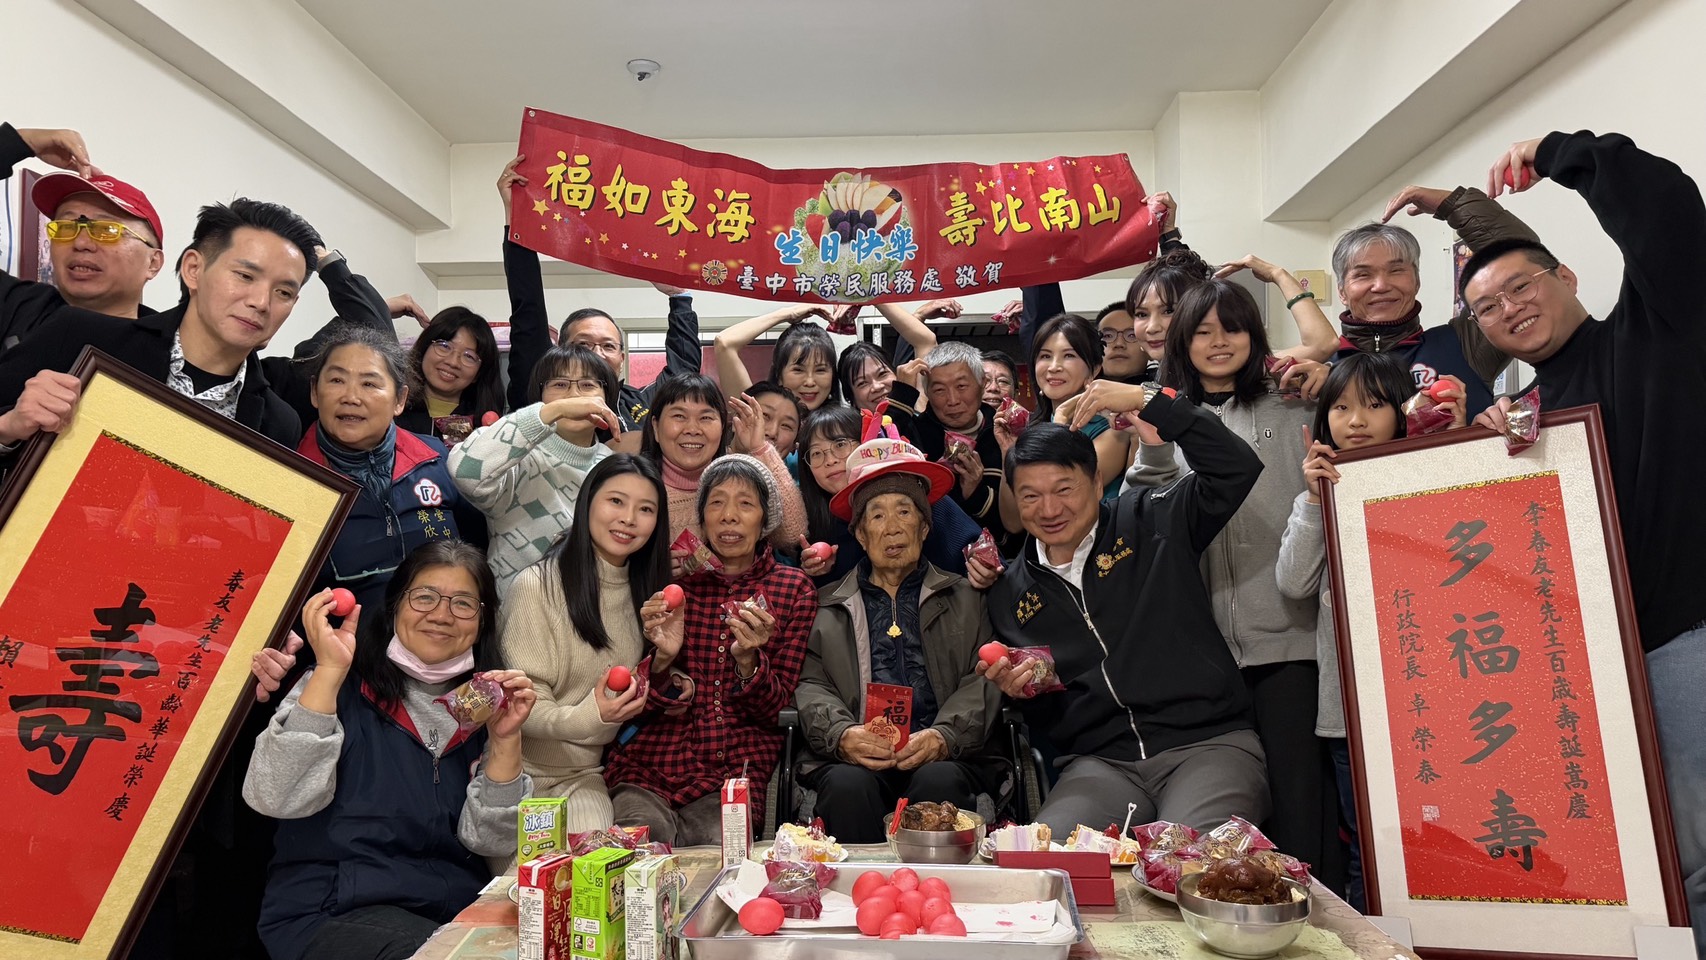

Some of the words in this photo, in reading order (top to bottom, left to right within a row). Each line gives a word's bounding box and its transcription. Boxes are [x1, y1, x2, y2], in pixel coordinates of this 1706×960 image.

[543, 150, 756, 244] 福如東海
[938, 183, 1121, 247] 壽比南山
[736, 266, 943, 297] 臺中市榮民服務處
[955, 261, 1004, 288] 敬賀
[775, 225, 918, 264] 生日快樂
[1392, 589, 1427, 681] 行政院長
[1520, 500, 1592, 821] 李春友老先生百歲壽誕嵩慶
[8, 582, 160, 795] 壽
[104, 569, 245, 821] 春友老先生百齡華誕榮慶
[882, 699, 908, 726] 福
[1439, 519, 1547, 872] 多福多壽
[1407, 693, 1441, 784] 卓榮泰
